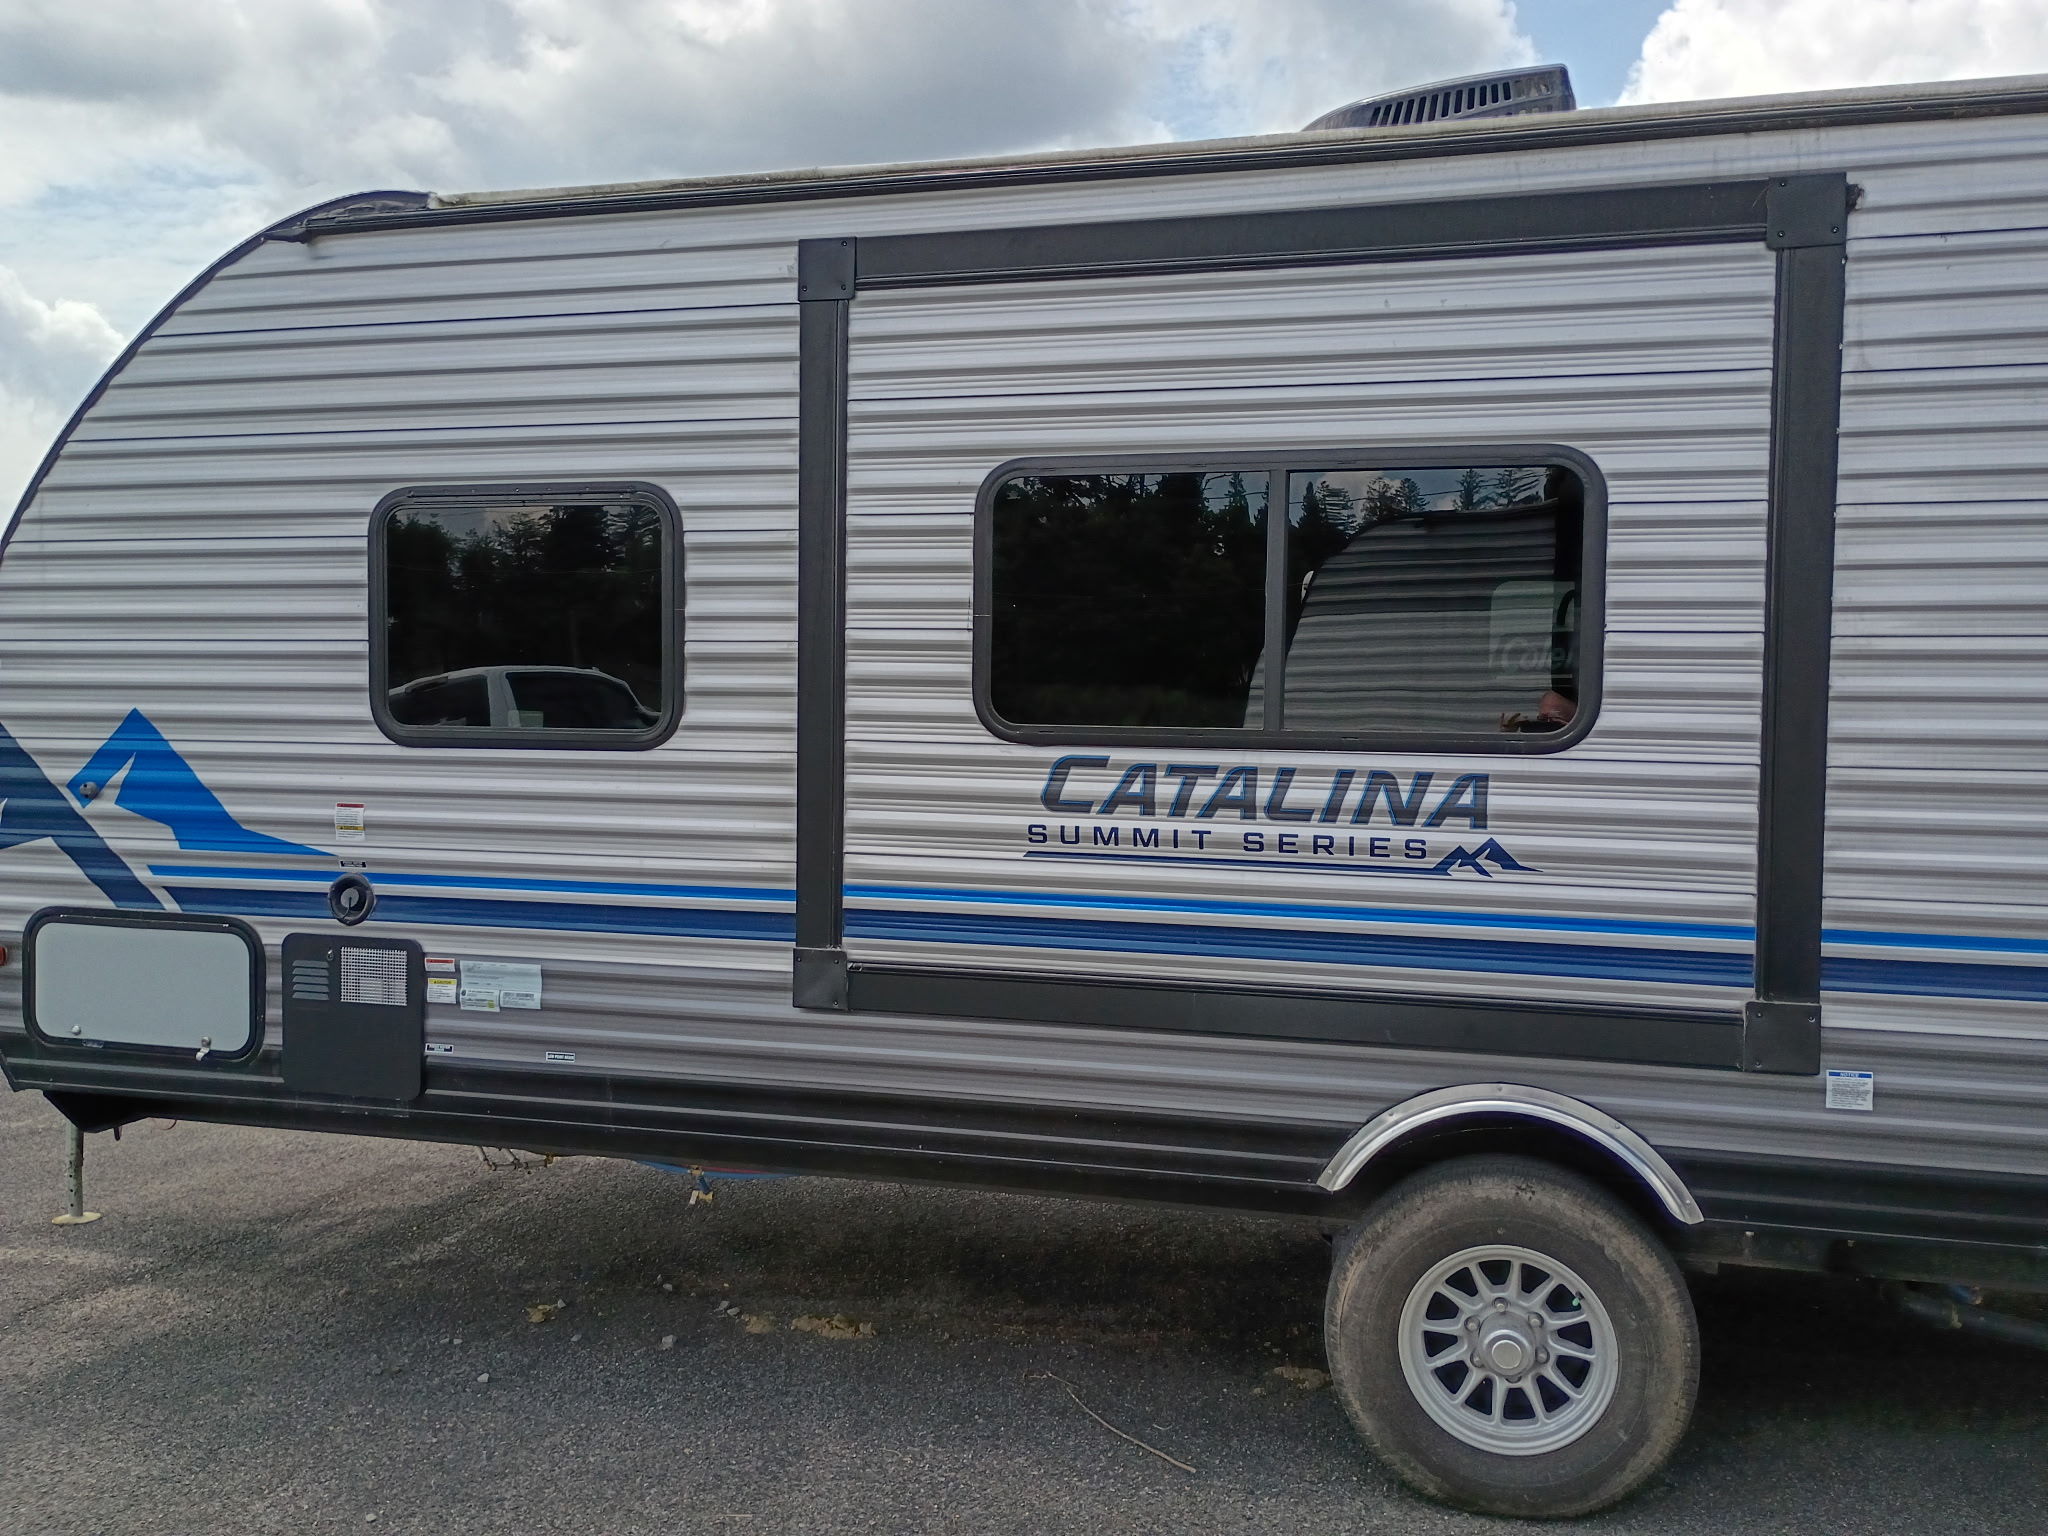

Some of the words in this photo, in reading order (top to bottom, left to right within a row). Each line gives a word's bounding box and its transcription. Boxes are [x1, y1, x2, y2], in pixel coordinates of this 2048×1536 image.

[1040, 755, 1489, 830] CATALINA
[1028, 824, 1211, 850] SUMMIT
[1243, 832, 1427, 860] SERIES
